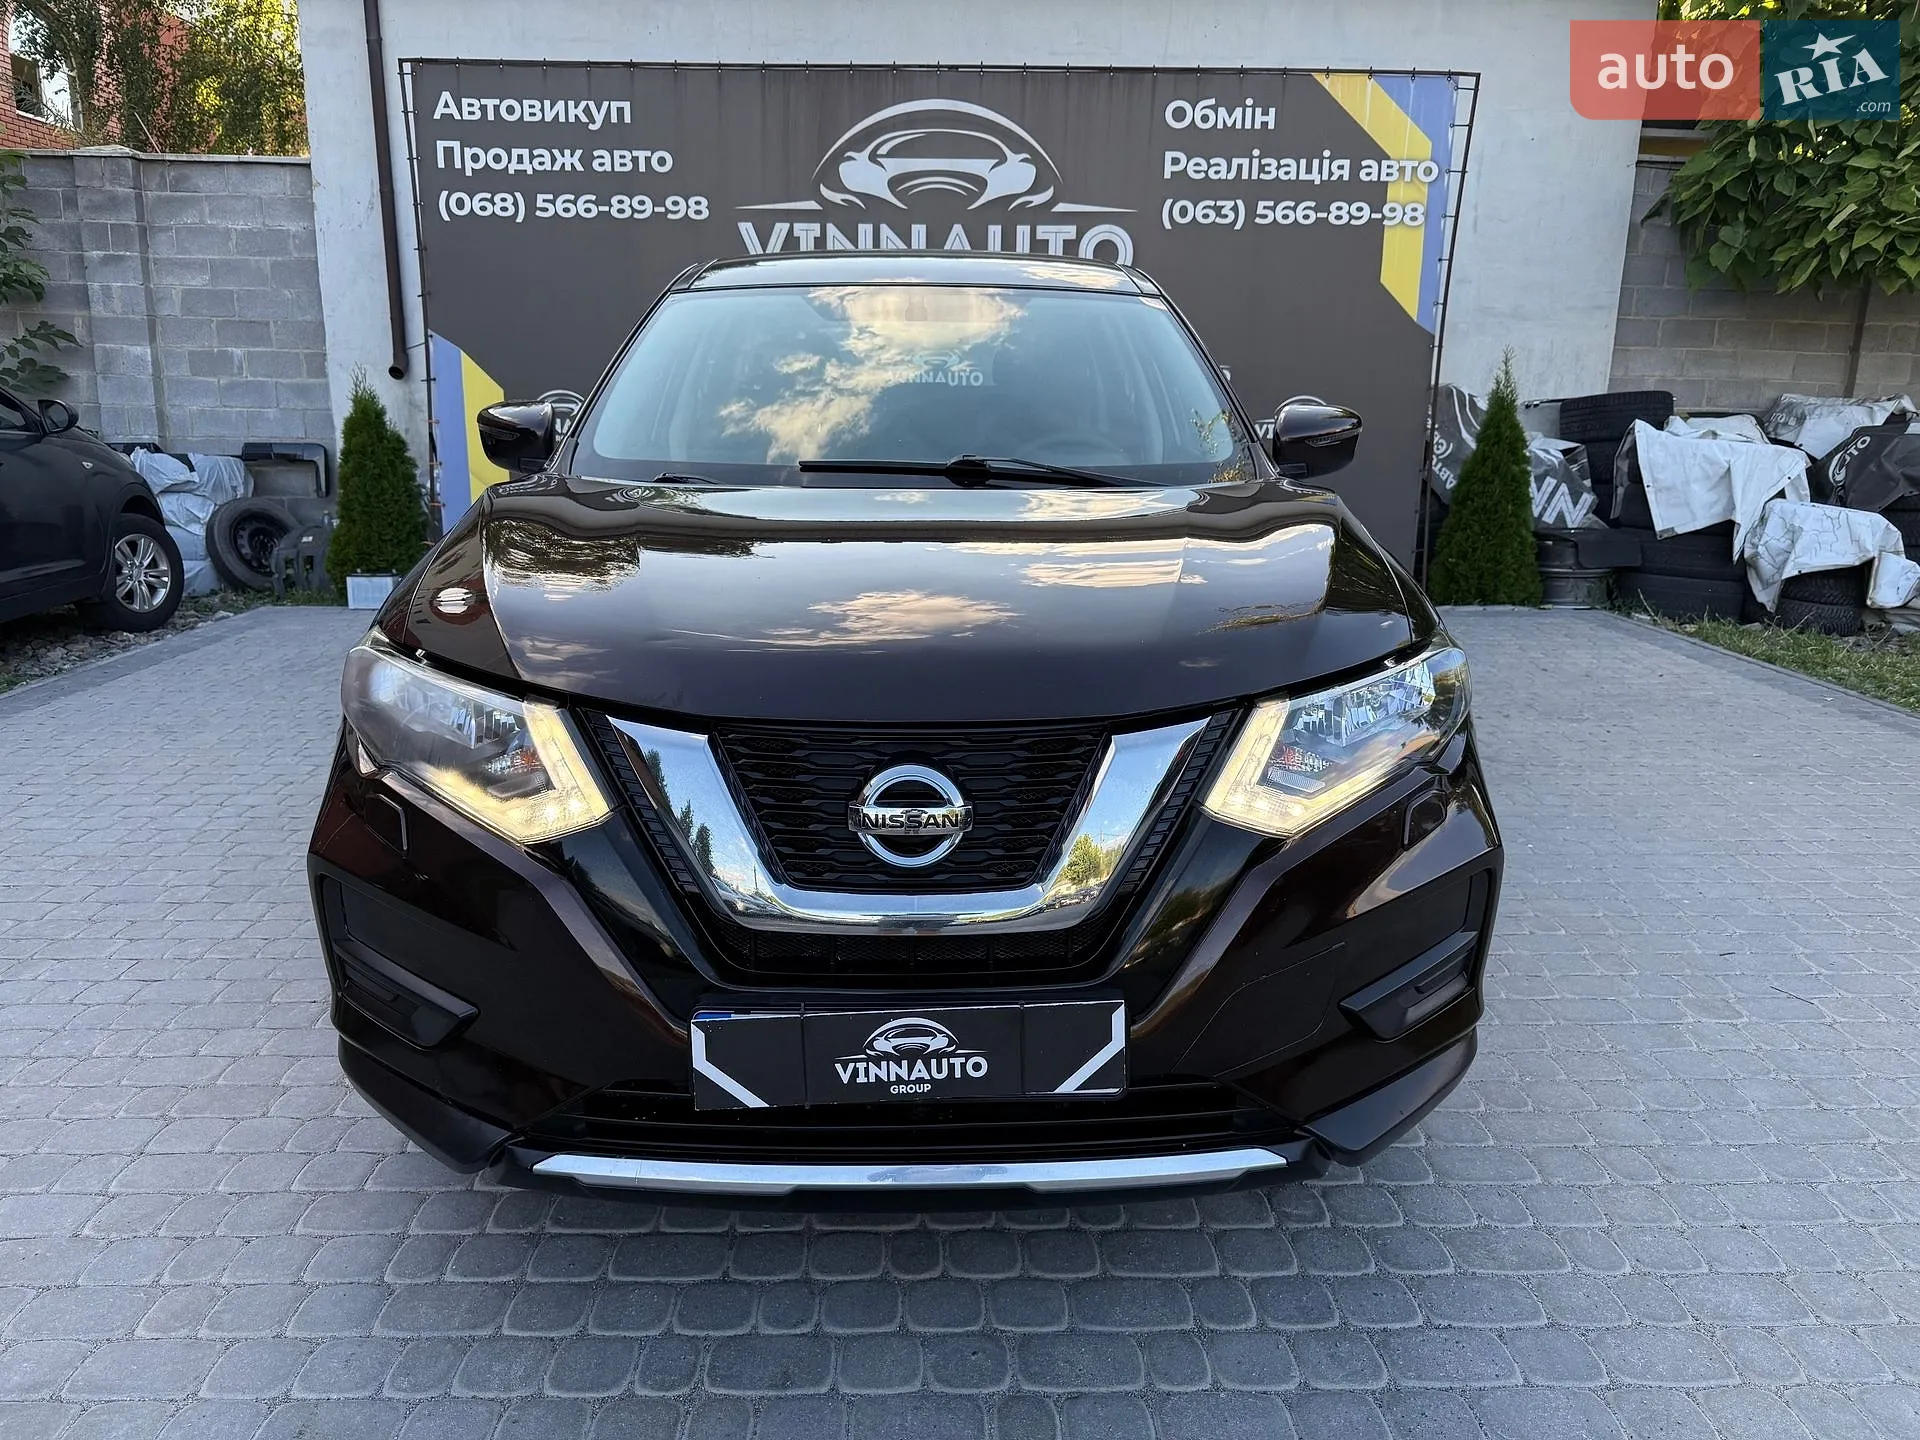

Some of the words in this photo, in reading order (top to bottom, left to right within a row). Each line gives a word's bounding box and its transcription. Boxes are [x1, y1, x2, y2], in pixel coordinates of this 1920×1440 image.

[433, 90, 632, 131] Автовикуп
[1164, 97, 1276, 130] Обмін
[436, 140, 585, 177] Продаж
[591, 149, 674, 174] авто
[1163, 148, 1351, 185] Реалізація
[1358, 159, 1440, 185] авто
[438, 190, 527, 224] (068)
[535, 193, 711, 221] 566-89-98
[1161, 198, 1246, 230] (063)
[1254, 200, 1426, 228] 566-89-98
[861, 813, 959, 829] NISSAN
[834, 1055, 989, 1085] VINNAUTO
[889, 1083, 932, 1094] GROUP
